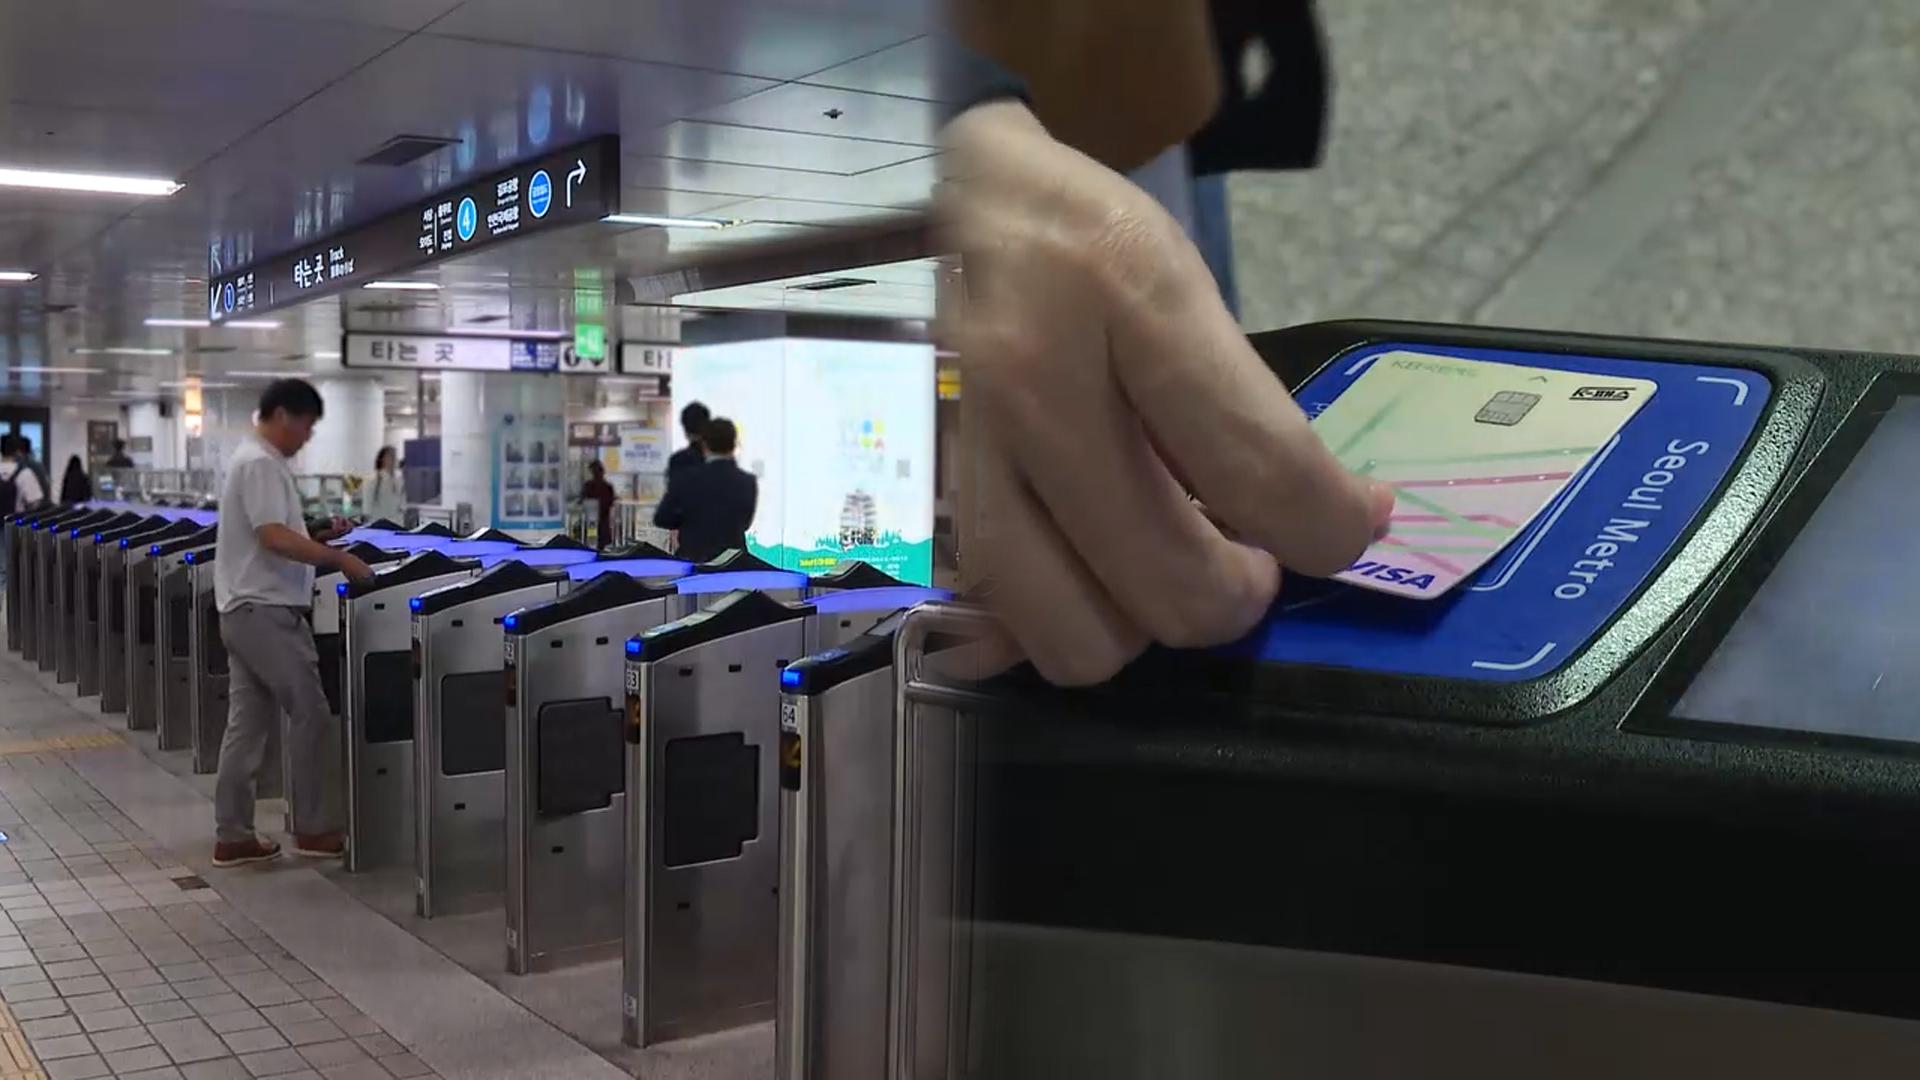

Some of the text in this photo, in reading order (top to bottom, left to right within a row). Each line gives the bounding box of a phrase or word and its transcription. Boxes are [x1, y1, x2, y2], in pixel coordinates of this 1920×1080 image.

[294, 254, 324, 288] 타는 곳
[371, 341, 454, 363] 타는 곳
[1554, 438, 1709, 601] Seoul Metro
